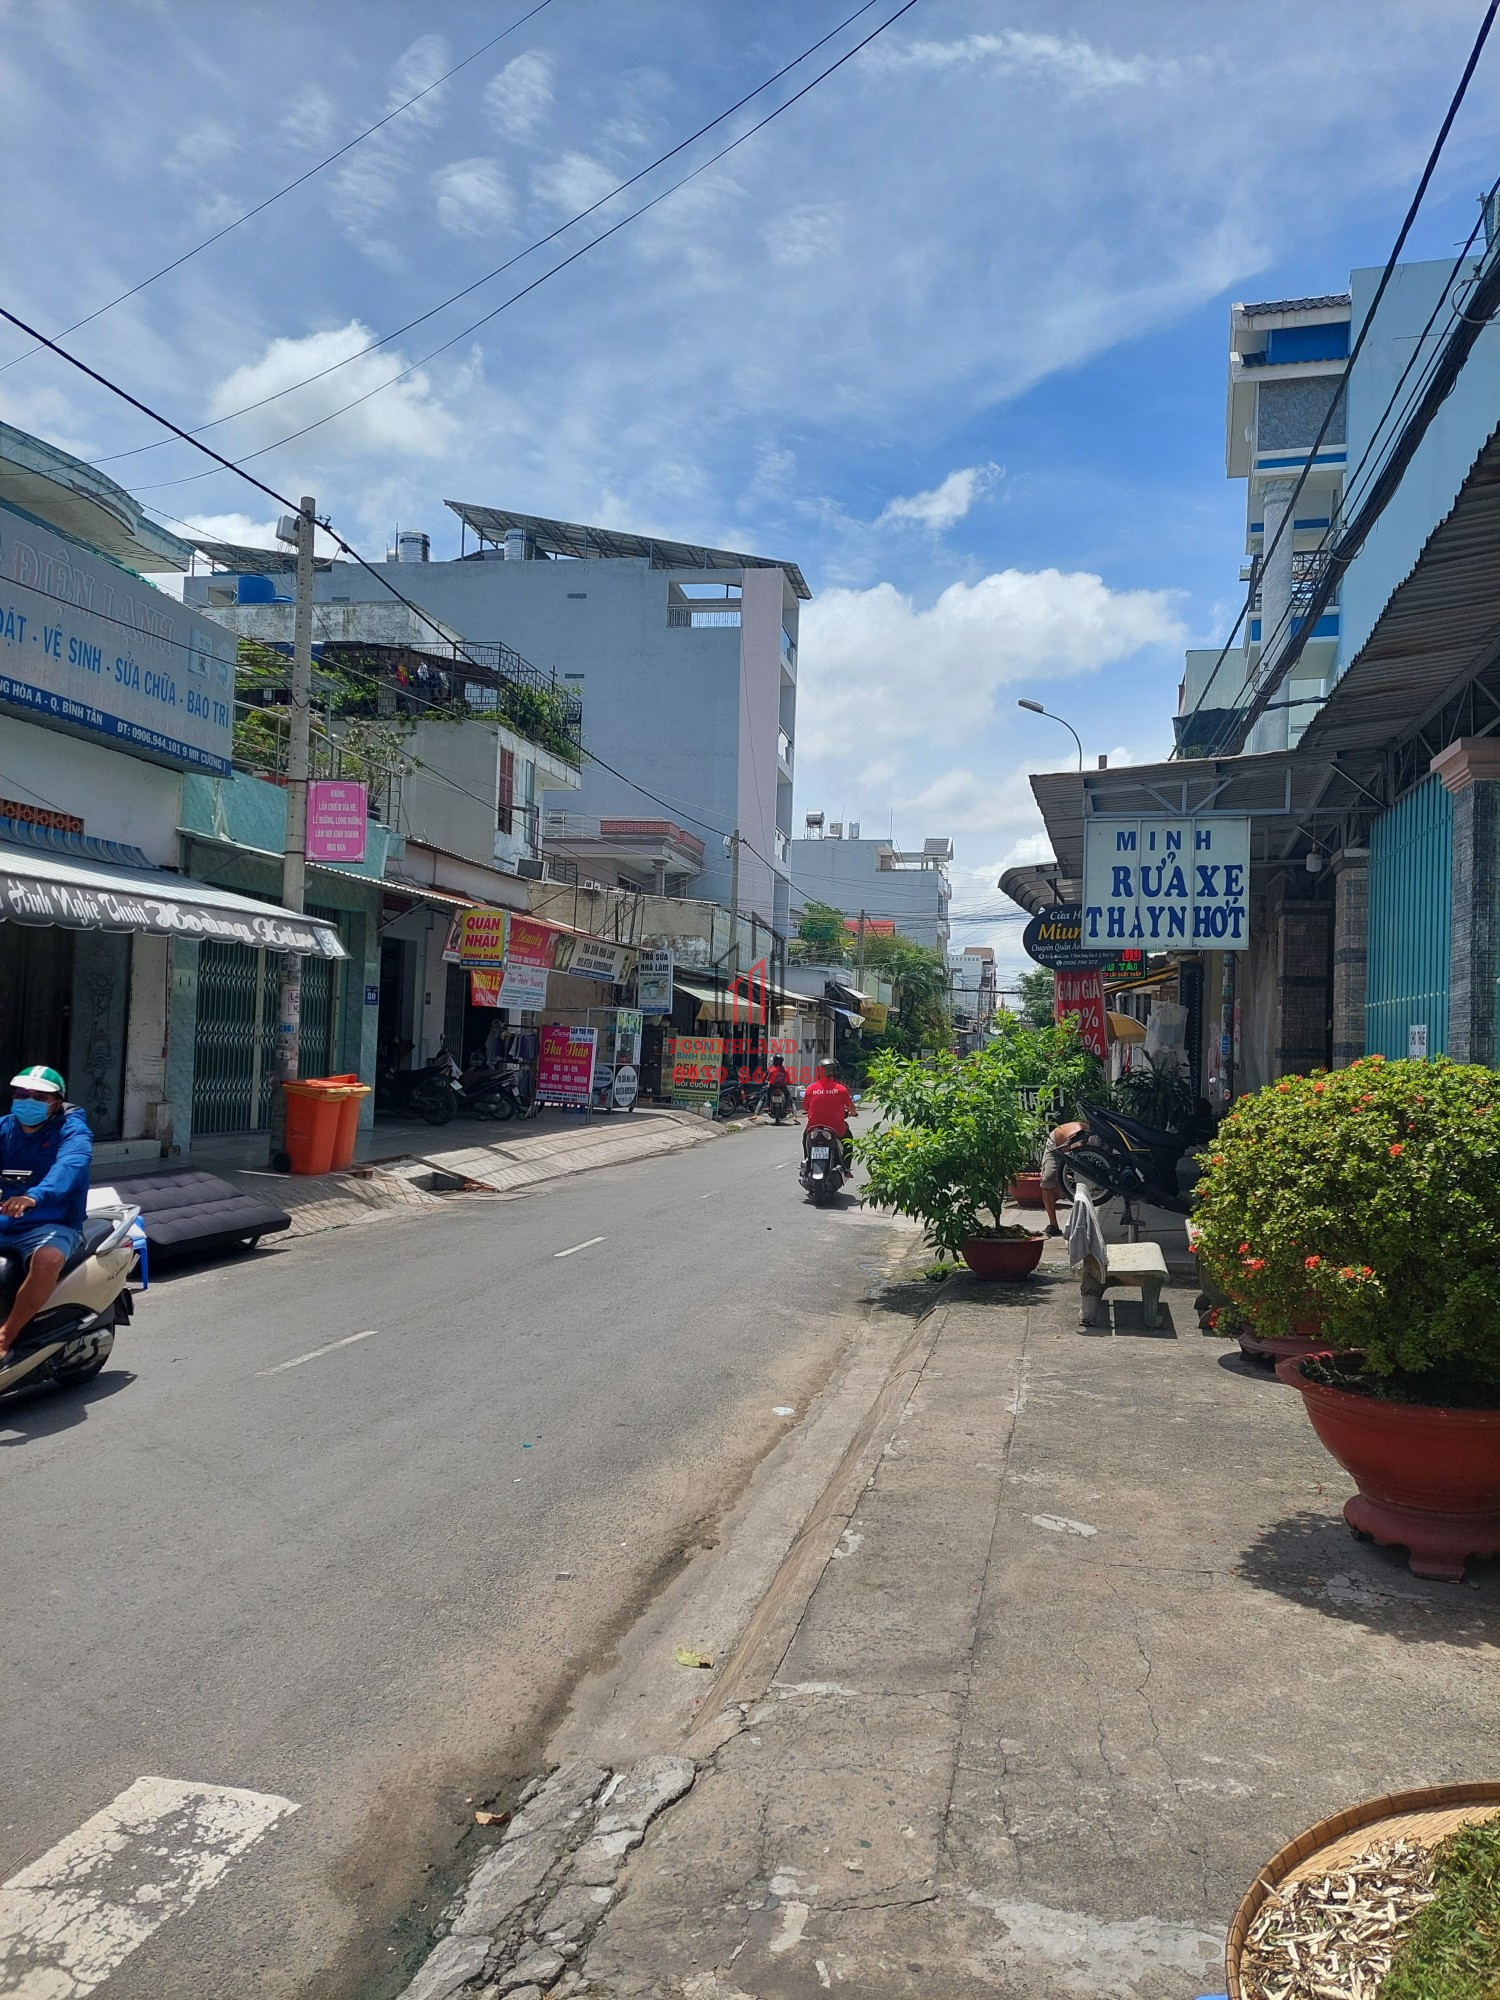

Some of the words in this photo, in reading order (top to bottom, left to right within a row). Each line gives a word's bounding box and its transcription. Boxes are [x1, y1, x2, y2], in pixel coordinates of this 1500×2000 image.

[44, 623, 64, 663] VỆ
[68, 636, 102, 674] SINH
[114, 651, 140, 691] SỬA
[144, 671, 176, 706] CHỮA
[186, 684, 210, 720] BẢO
[212, 700, 230, 729] TRÌ
[12, 682, 33, 702] HÒA
[35, 691, 42, 705] A
[50, 697, 60, 712] Q.
[62, 699, 84, 719] BÌNH
[86, 708, 103, 726] TÂN
[117, 720, 130, 738] ĐT:
[132, 726, 181, 755] 0906.944.101
[189, 748, 199, 762] MR
[1116, 831, 1212, 851] MINH
[466, 914, 501, 931] QUÁN
[1050, 909, 1070, 921] Cửa
[464, 932, 500, 953] NHẬU
[516, 927, 544, 950] Beauty
[1032, 942, 1054, 953] Chuyên
[655, 952, 669, 961] SỮA
[655, 962, 669, 972] LÀM
[1057, 973, 1081, 1001] GIẢM
[1082, 973, 1101, 1001] GIÁ
[544, 1039, 562, 1056] Thu
